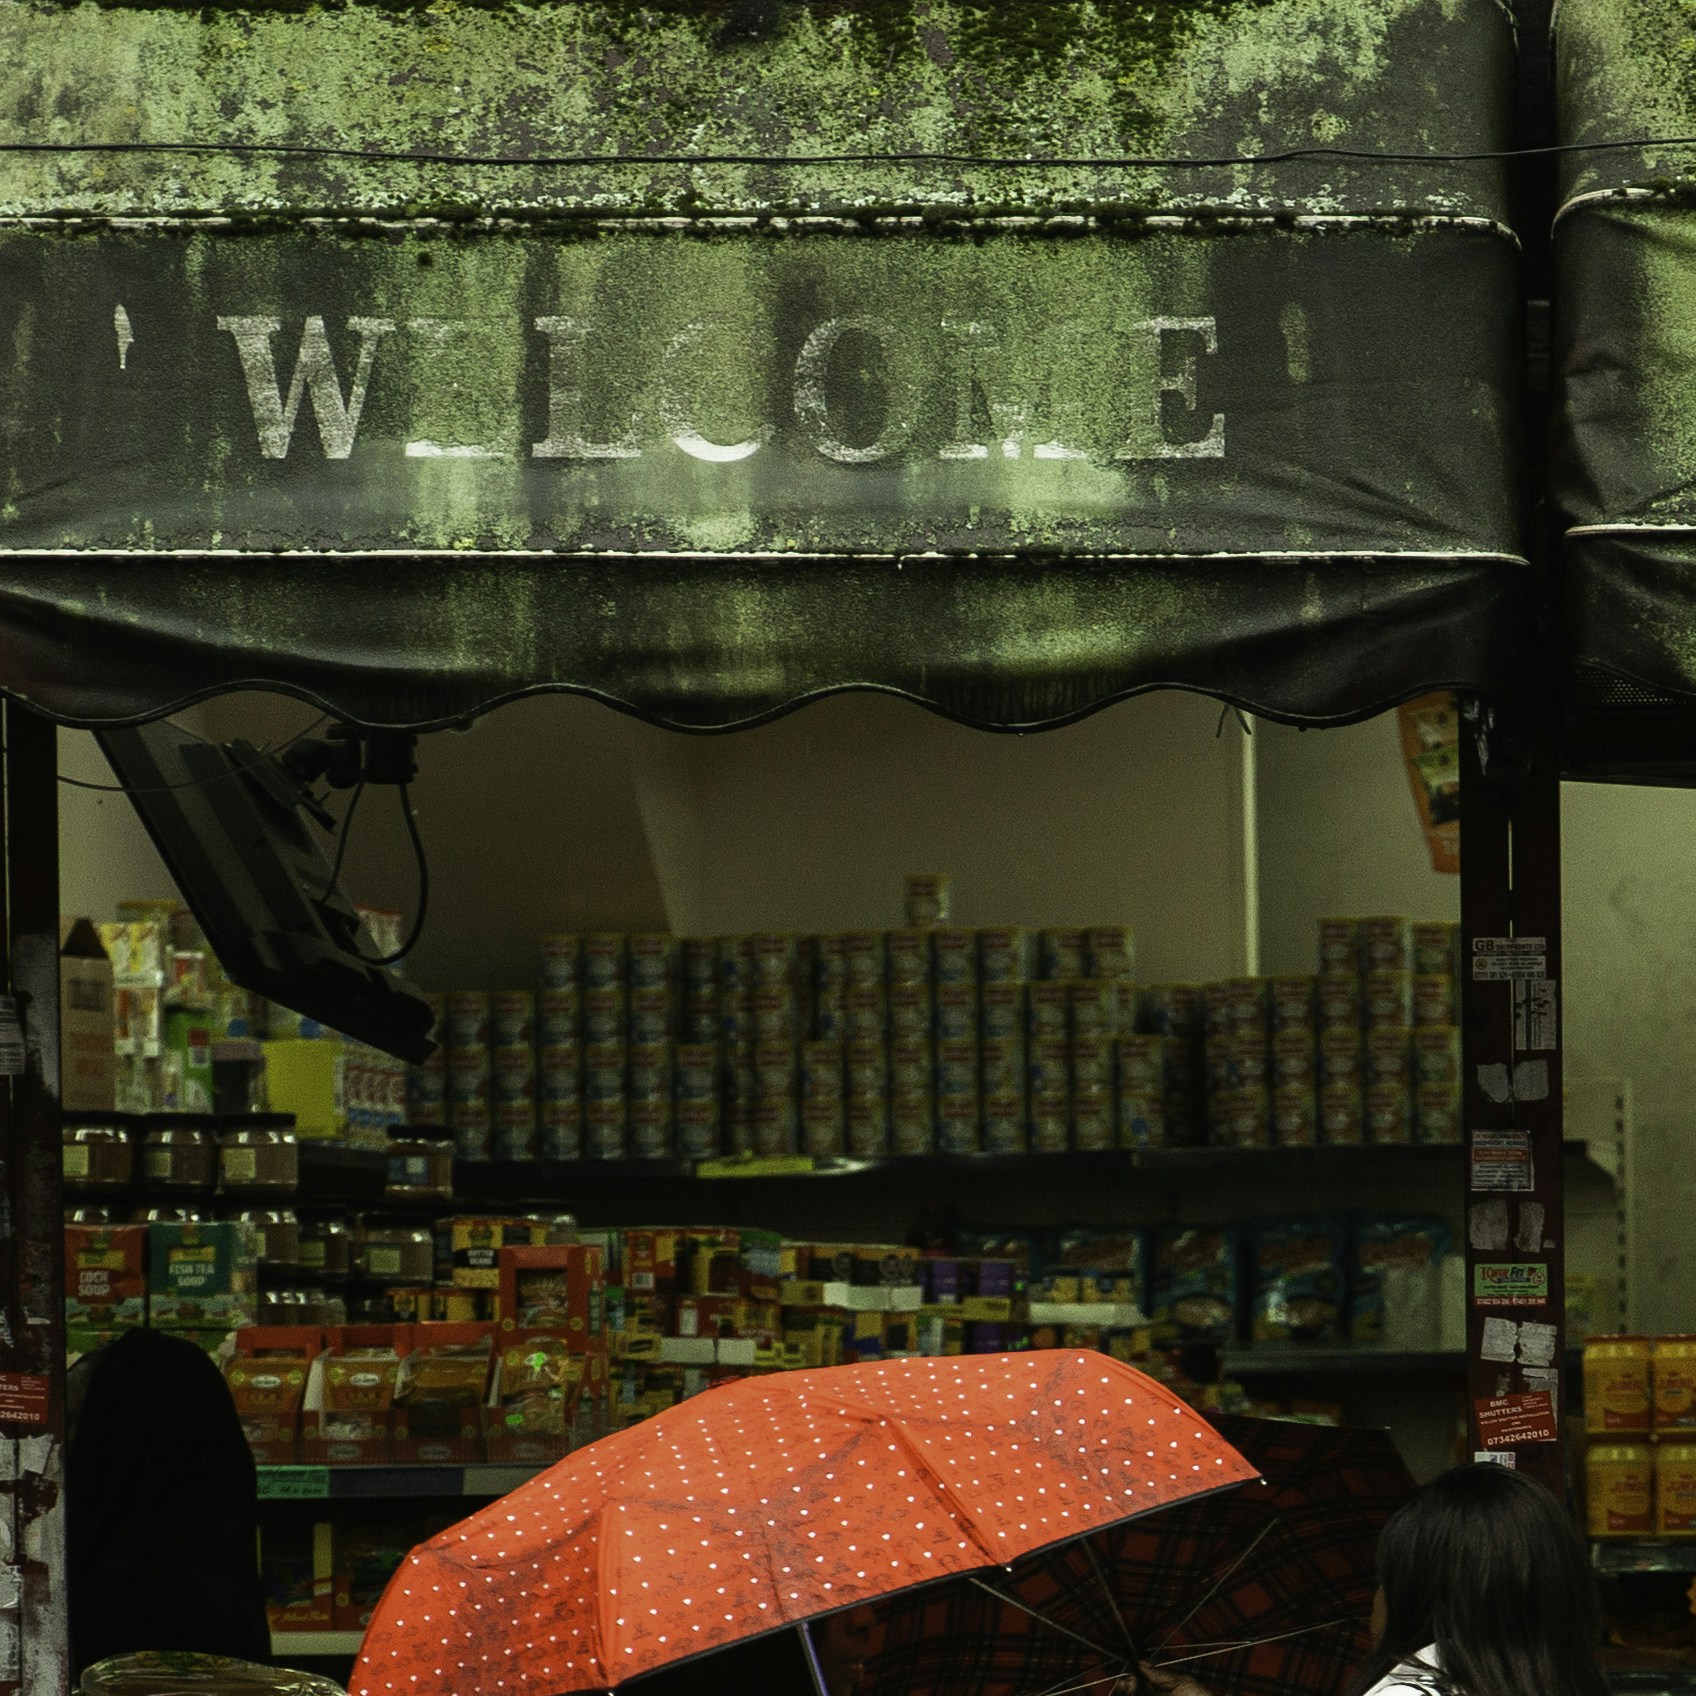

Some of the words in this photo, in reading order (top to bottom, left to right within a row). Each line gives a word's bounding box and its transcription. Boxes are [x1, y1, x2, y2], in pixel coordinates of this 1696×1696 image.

[216, 313, 1228, 463] WLCOME
[1475, 939, 1495, 951] GB
[1489, 1398, 1509, 1408] BMC
[1478, 1405, 1523, 1419] SHUTTERS
[1487, 1429, 1550, 1446] 07342642010
